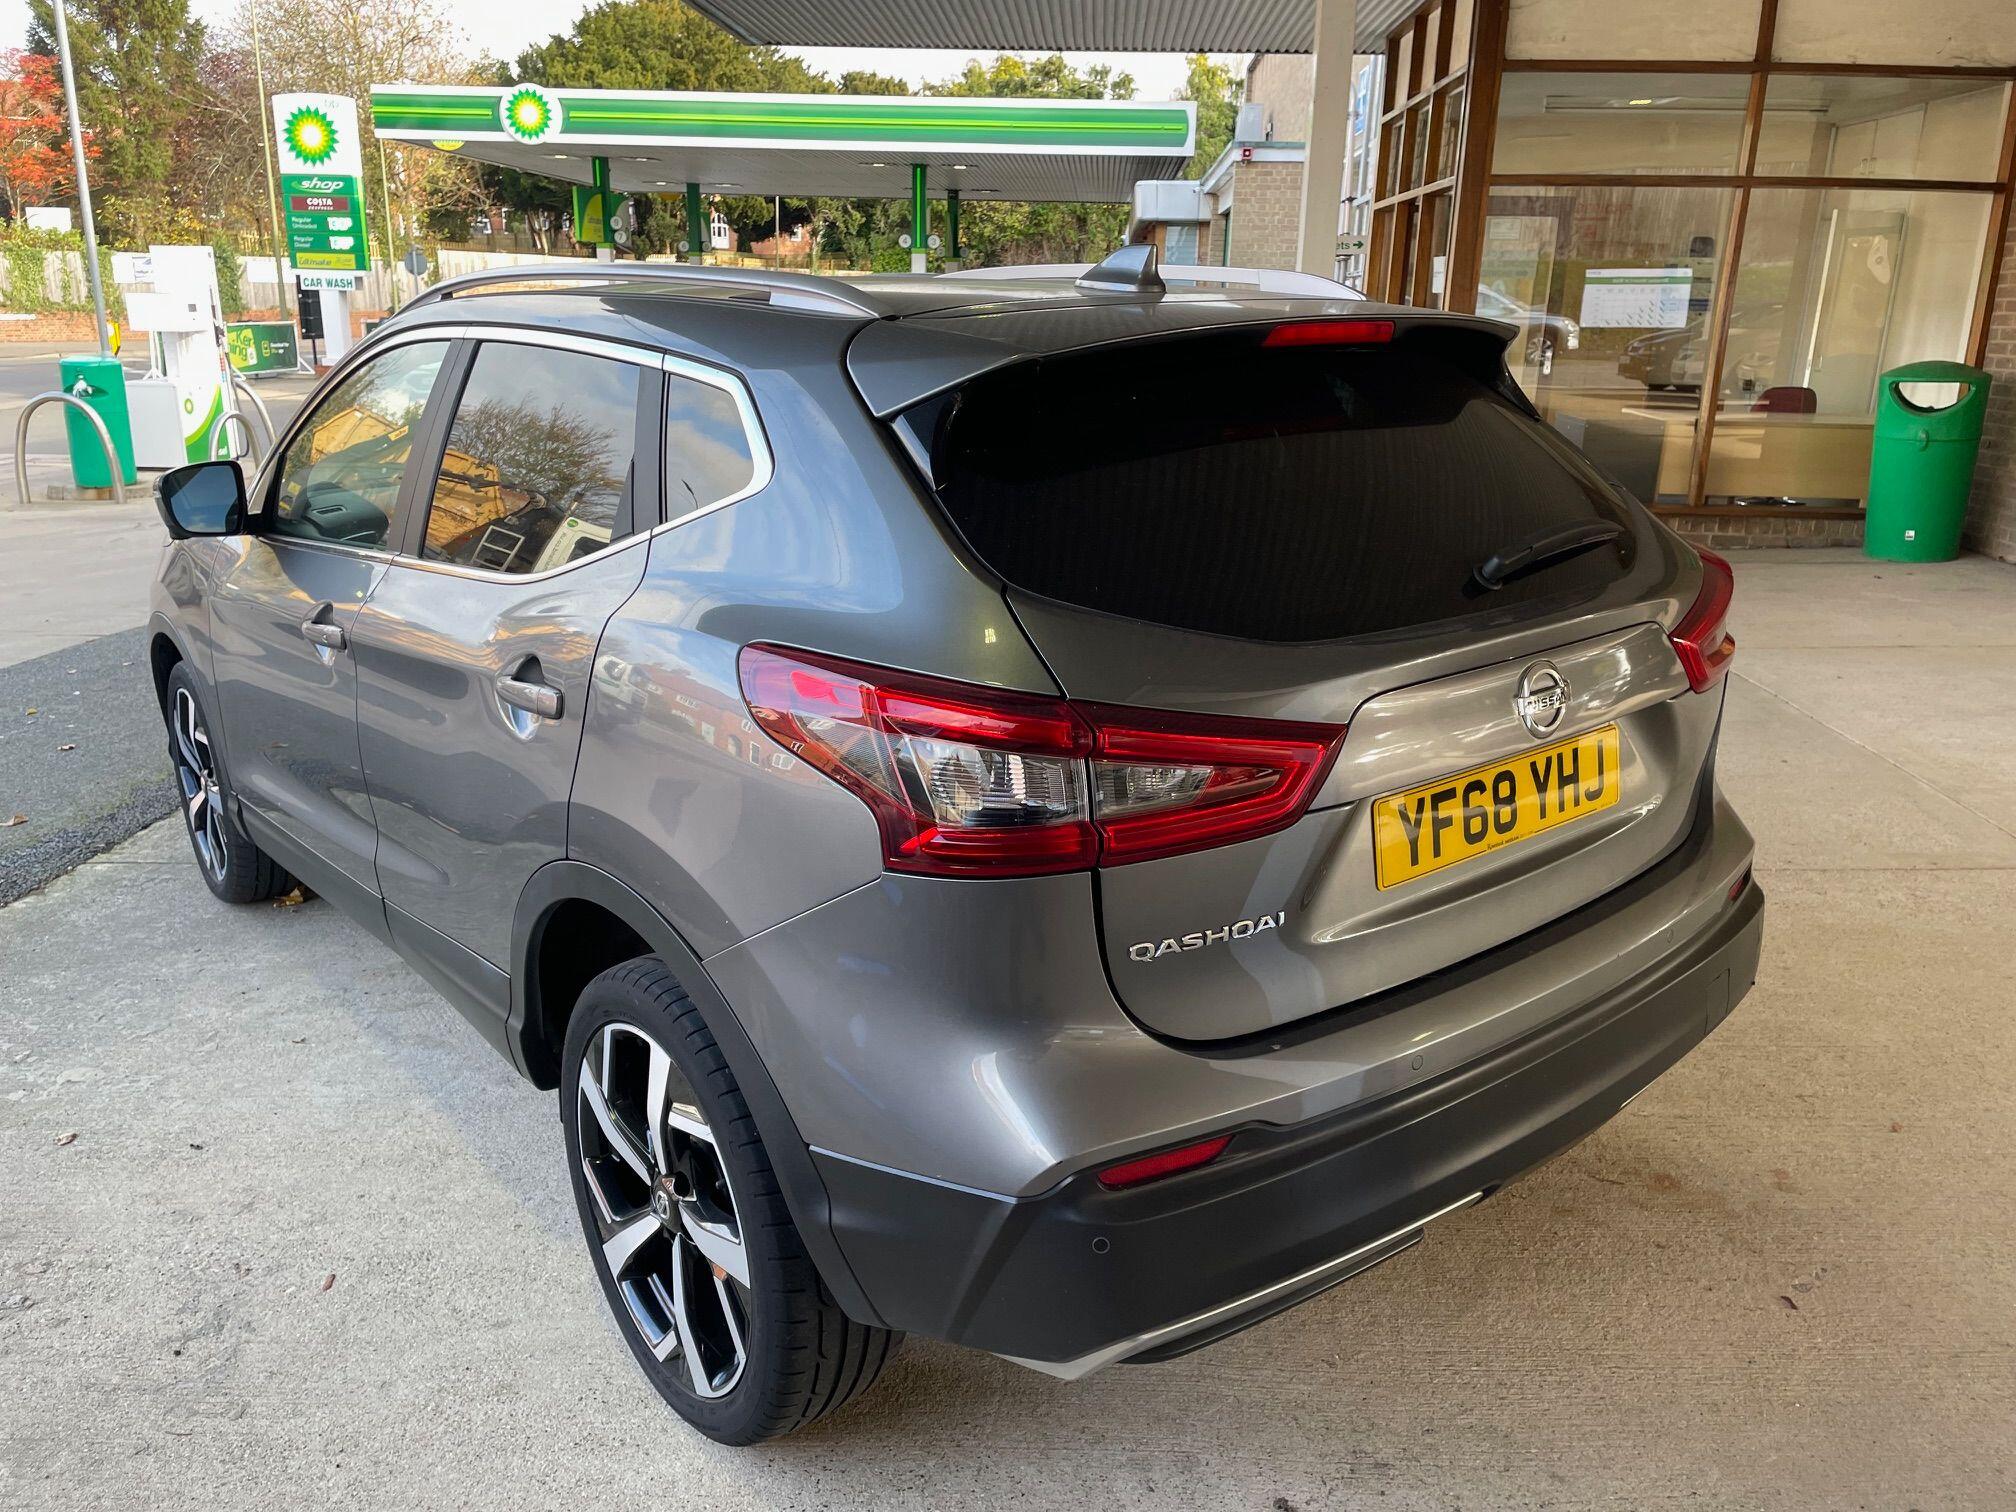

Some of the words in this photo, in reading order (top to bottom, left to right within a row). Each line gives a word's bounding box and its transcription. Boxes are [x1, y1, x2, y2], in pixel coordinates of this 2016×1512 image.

[301, 177, 344, 193] shop
[306, 197, 334, 206] COSTA
[303, 277, 322, 288] CAR
[326, 277, 353, 289] WASH
[1397, 769, 1518, 868] YF68
[1529, 738, 1605, 820] YHJ
[1129, 910, 1286, 962] QASHQAI
